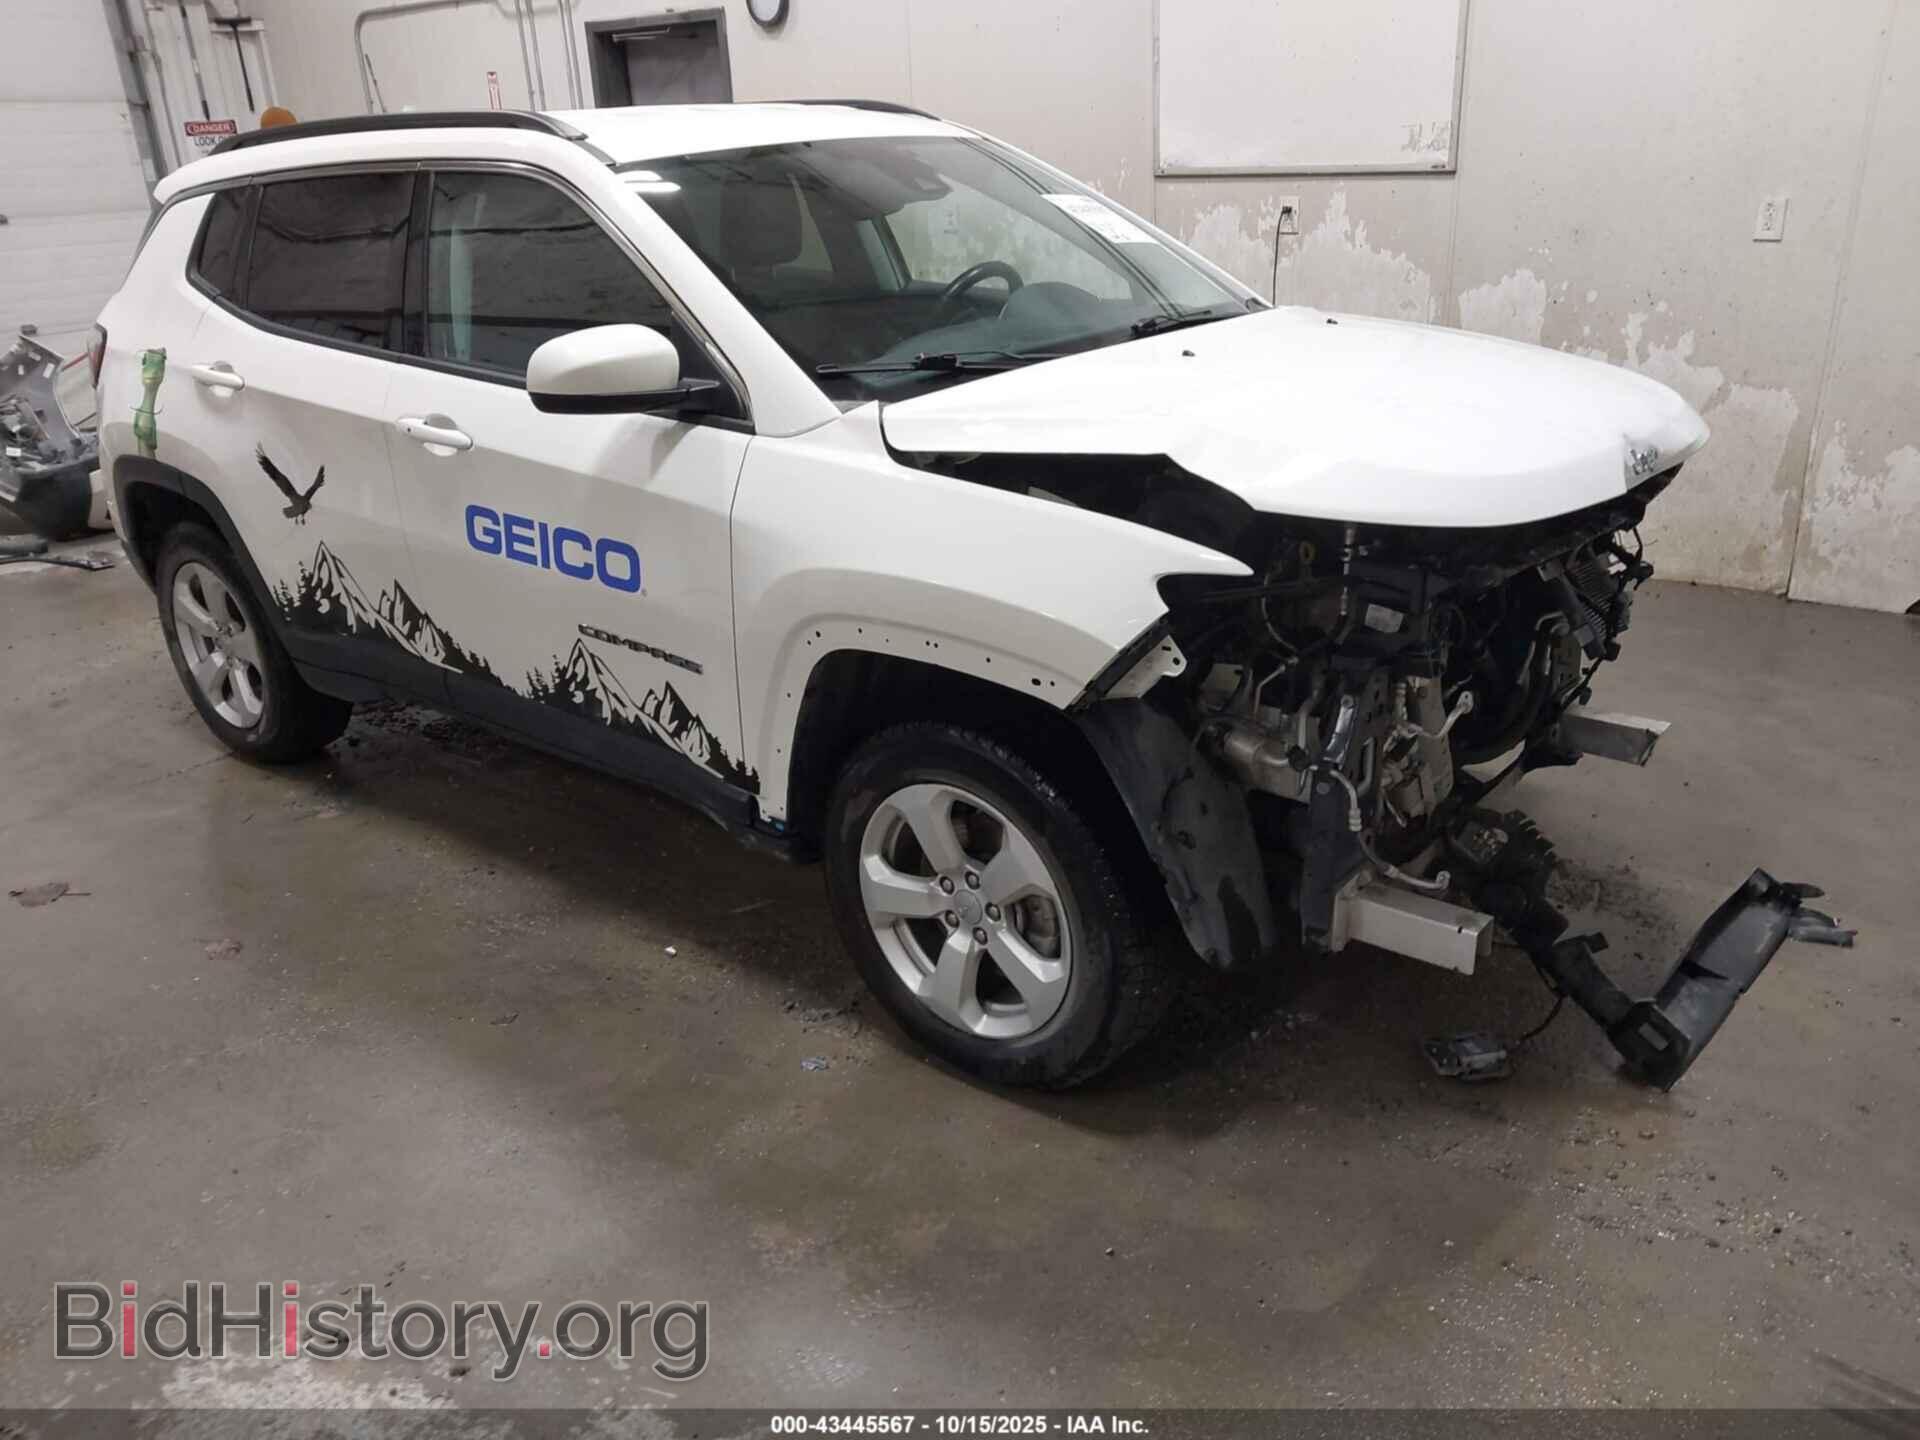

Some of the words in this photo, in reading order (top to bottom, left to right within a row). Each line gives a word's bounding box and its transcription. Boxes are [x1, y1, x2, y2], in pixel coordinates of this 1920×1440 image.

[192, 122, 232, 133] DANGER
[194, 135, 217, 146] LOOK
[465, 504, 642, 593] GEICO
